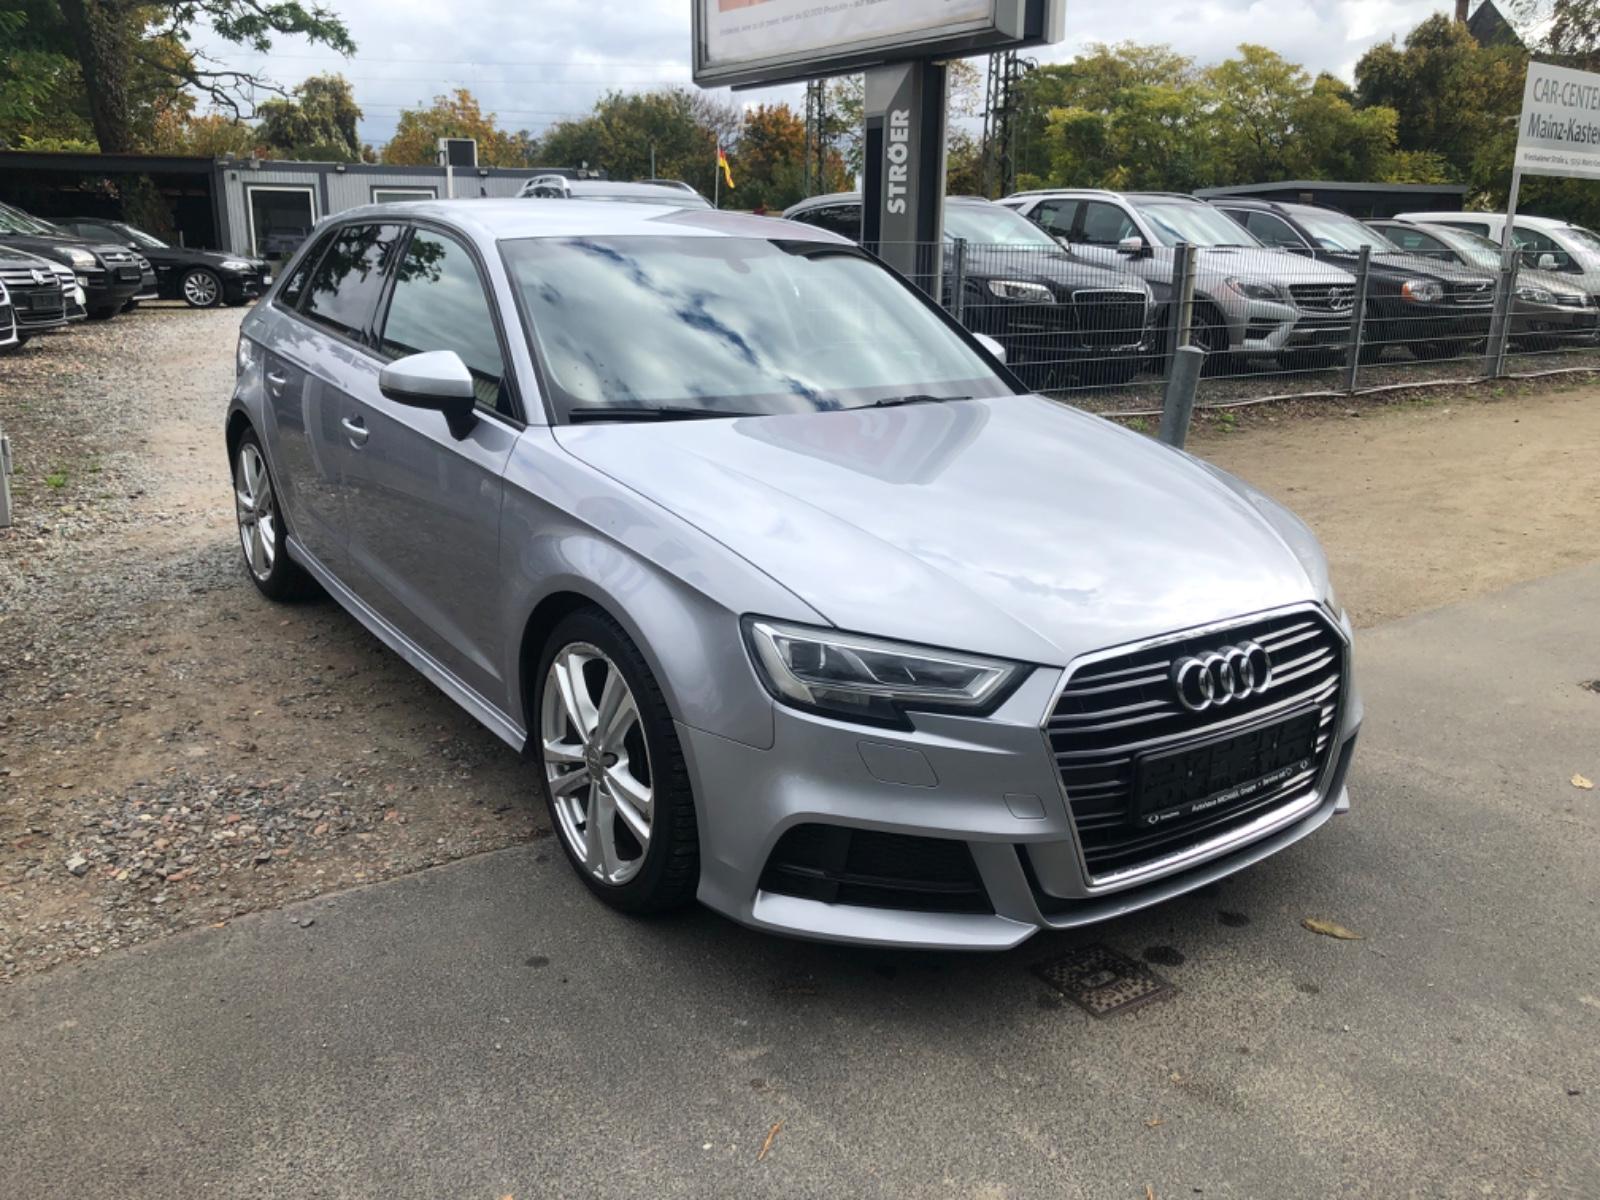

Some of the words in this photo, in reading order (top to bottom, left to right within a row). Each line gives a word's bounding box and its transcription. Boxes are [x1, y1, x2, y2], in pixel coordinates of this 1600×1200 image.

[1533, 77, 1600, 111] CAR-CENTE
[1527, 112, 1600, 145] Mainz-Kaste
[887, 108, 910, 215] STRÖER
